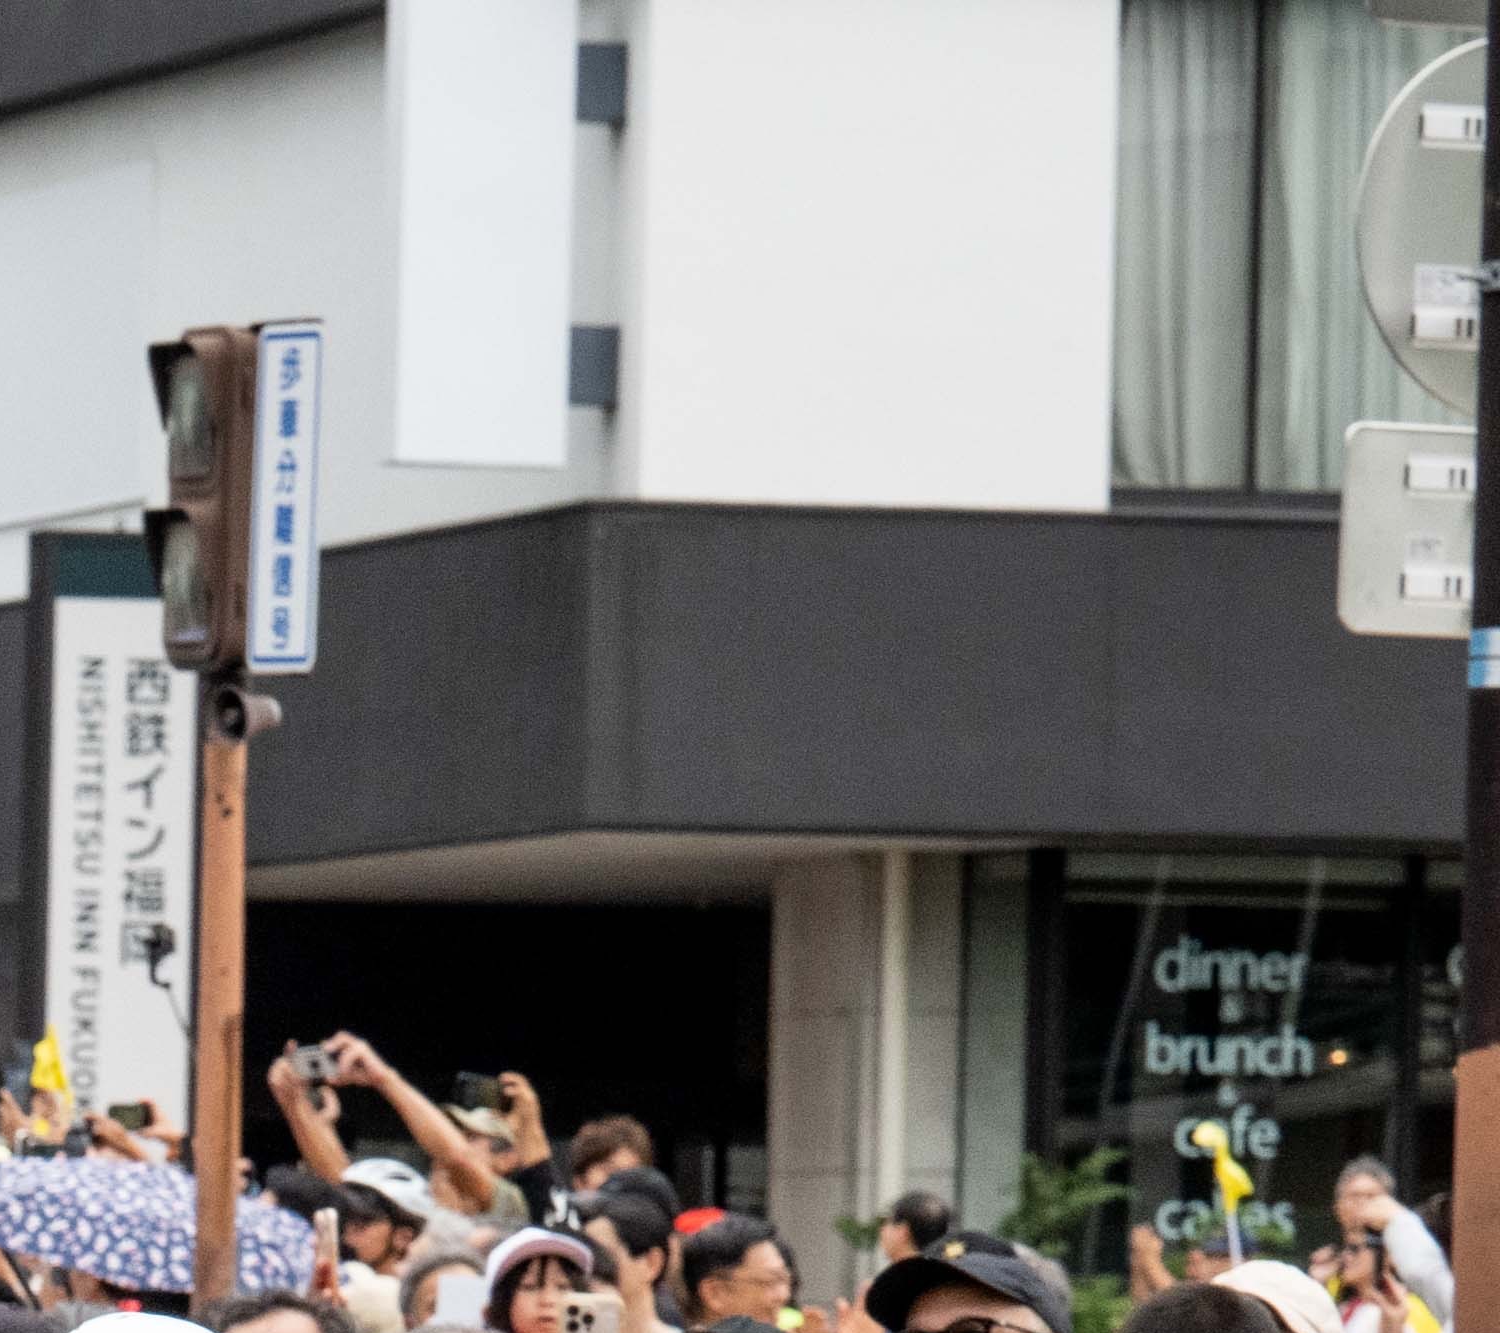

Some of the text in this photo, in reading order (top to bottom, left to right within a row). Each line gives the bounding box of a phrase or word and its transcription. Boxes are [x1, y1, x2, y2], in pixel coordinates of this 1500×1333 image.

[71, 656, 106, 1112] NISHITETSU INN FUKUOK
[1152, 935, 1308, 993] dinner
[1144, 1020, 1316, 1077] brunch
[1172, 1105, 1282, 1161] cfe
